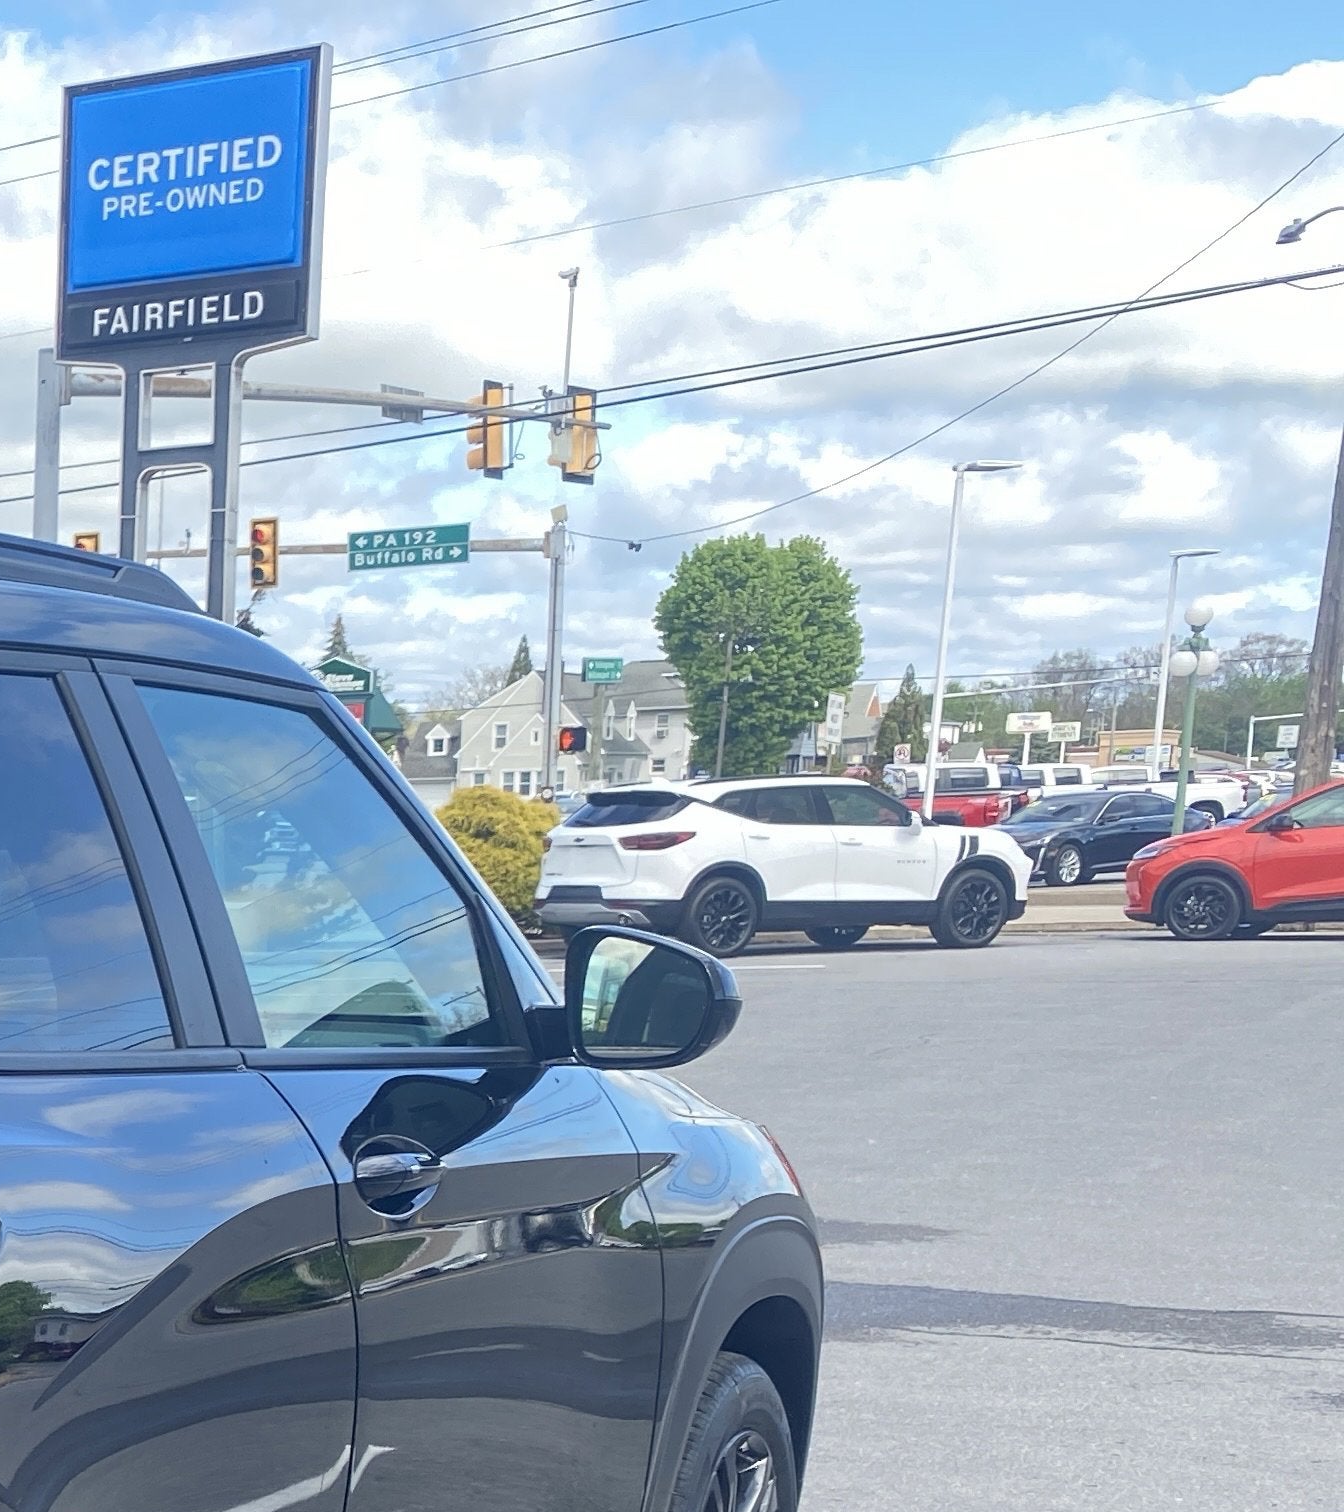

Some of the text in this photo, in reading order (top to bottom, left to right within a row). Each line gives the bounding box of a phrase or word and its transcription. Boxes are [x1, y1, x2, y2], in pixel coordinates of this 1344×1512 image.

[87, 134, 283, 191] CERTIFIED
[101, 177, 264, 221] PRE-OWNED
[92, 290, 264, 337] FAIRFIELD
[354, 547, 444, 567] Buffalo Rd
[372, 530, 437, 548] PA 192
